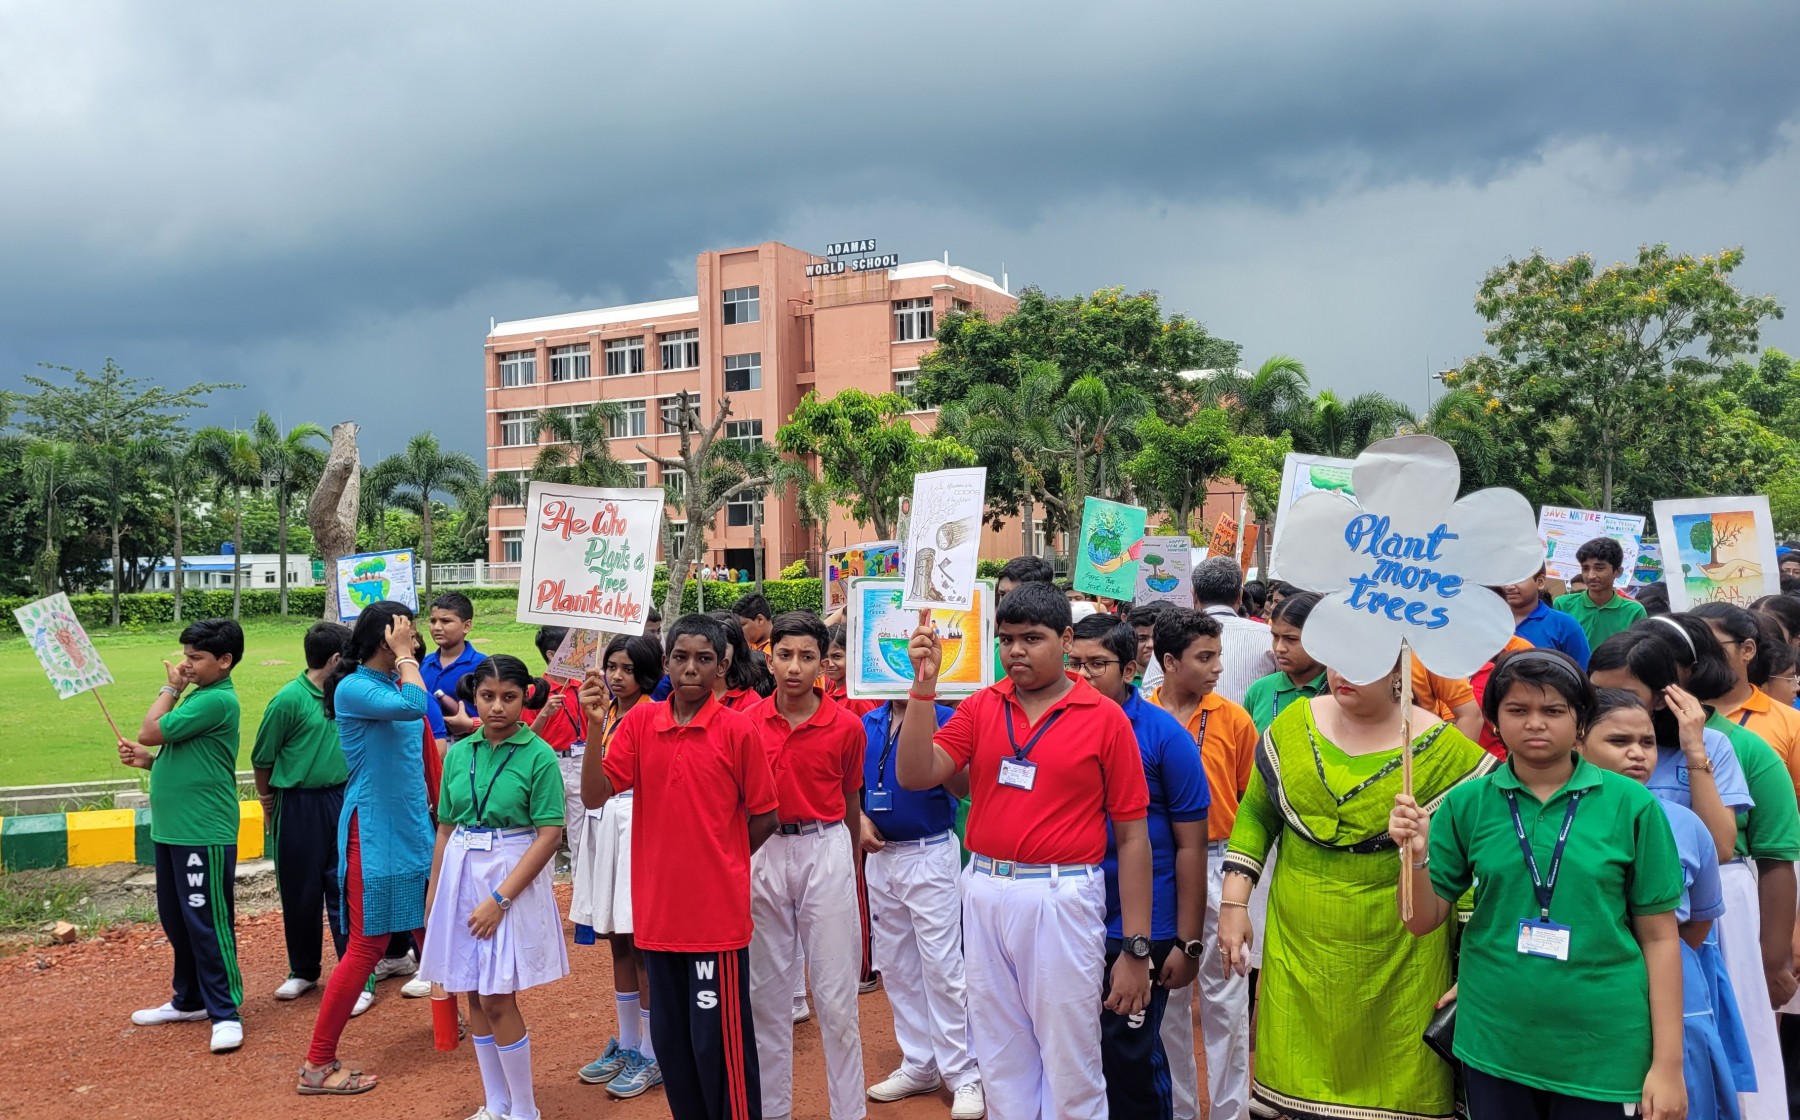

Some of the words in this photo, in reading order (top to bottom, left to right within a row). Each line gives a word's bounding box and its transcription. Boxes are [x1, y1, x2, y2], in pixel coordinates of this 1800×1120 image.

[828, 240, 875, 255] ADAMAS
[806, 261, 844, 276] WORLD
[852, 255, 896, 270] SCHOOL
[541, 500, 590, 541] He
[592, 502, 628, 536] Who
[1221, 514, 1238, 531] TAKE
[1544, 508, 1567, 519] SAVE
[1569, 510, 1601, 522] NATURE
[1344, 513, 1459, 562] Plant
[584, 536, 631, 571] Plants
[633, 552, 646, 571] a
[588, 566, 629, 592] Tree
[1372, 558, 1464, 599] more
[1705, 585, 1739, 600] VAN
[536, 579, 602, 614] Plants
[603, 596, 613, 615] a
[613, 592, 642, 625] hope
[1343, 573, 1450, 630] trees
